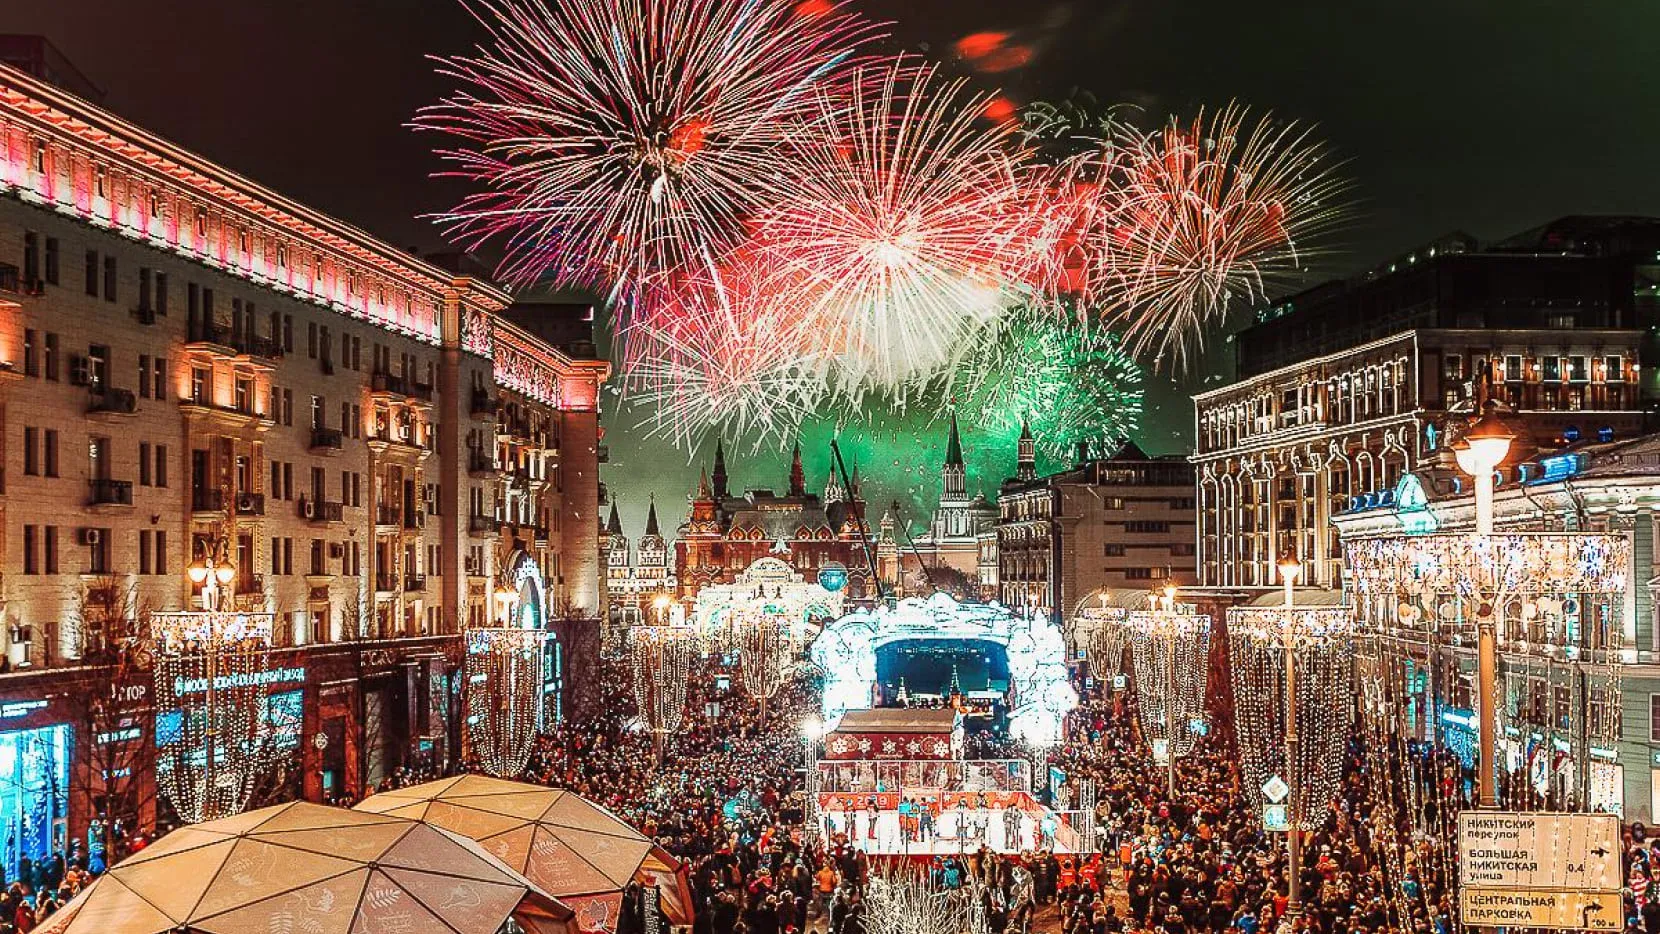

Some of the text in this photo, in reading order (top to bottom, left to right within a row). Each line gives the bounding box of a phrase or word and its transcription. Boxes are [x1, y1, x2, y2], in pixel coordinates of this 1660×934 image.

[1467, 819, 1535, 829] НИКИТСКИЙ
[1469, 849, 1528, 859] БОЛЬШАЯ
[1470, 861, 1538, 872] НИКИТСКАЯ
[1469, 895, 1556, 907] ЦЕНТРАЛЬНАЯ
[1470, 908, 1533, 920] ПАРКОВКА
